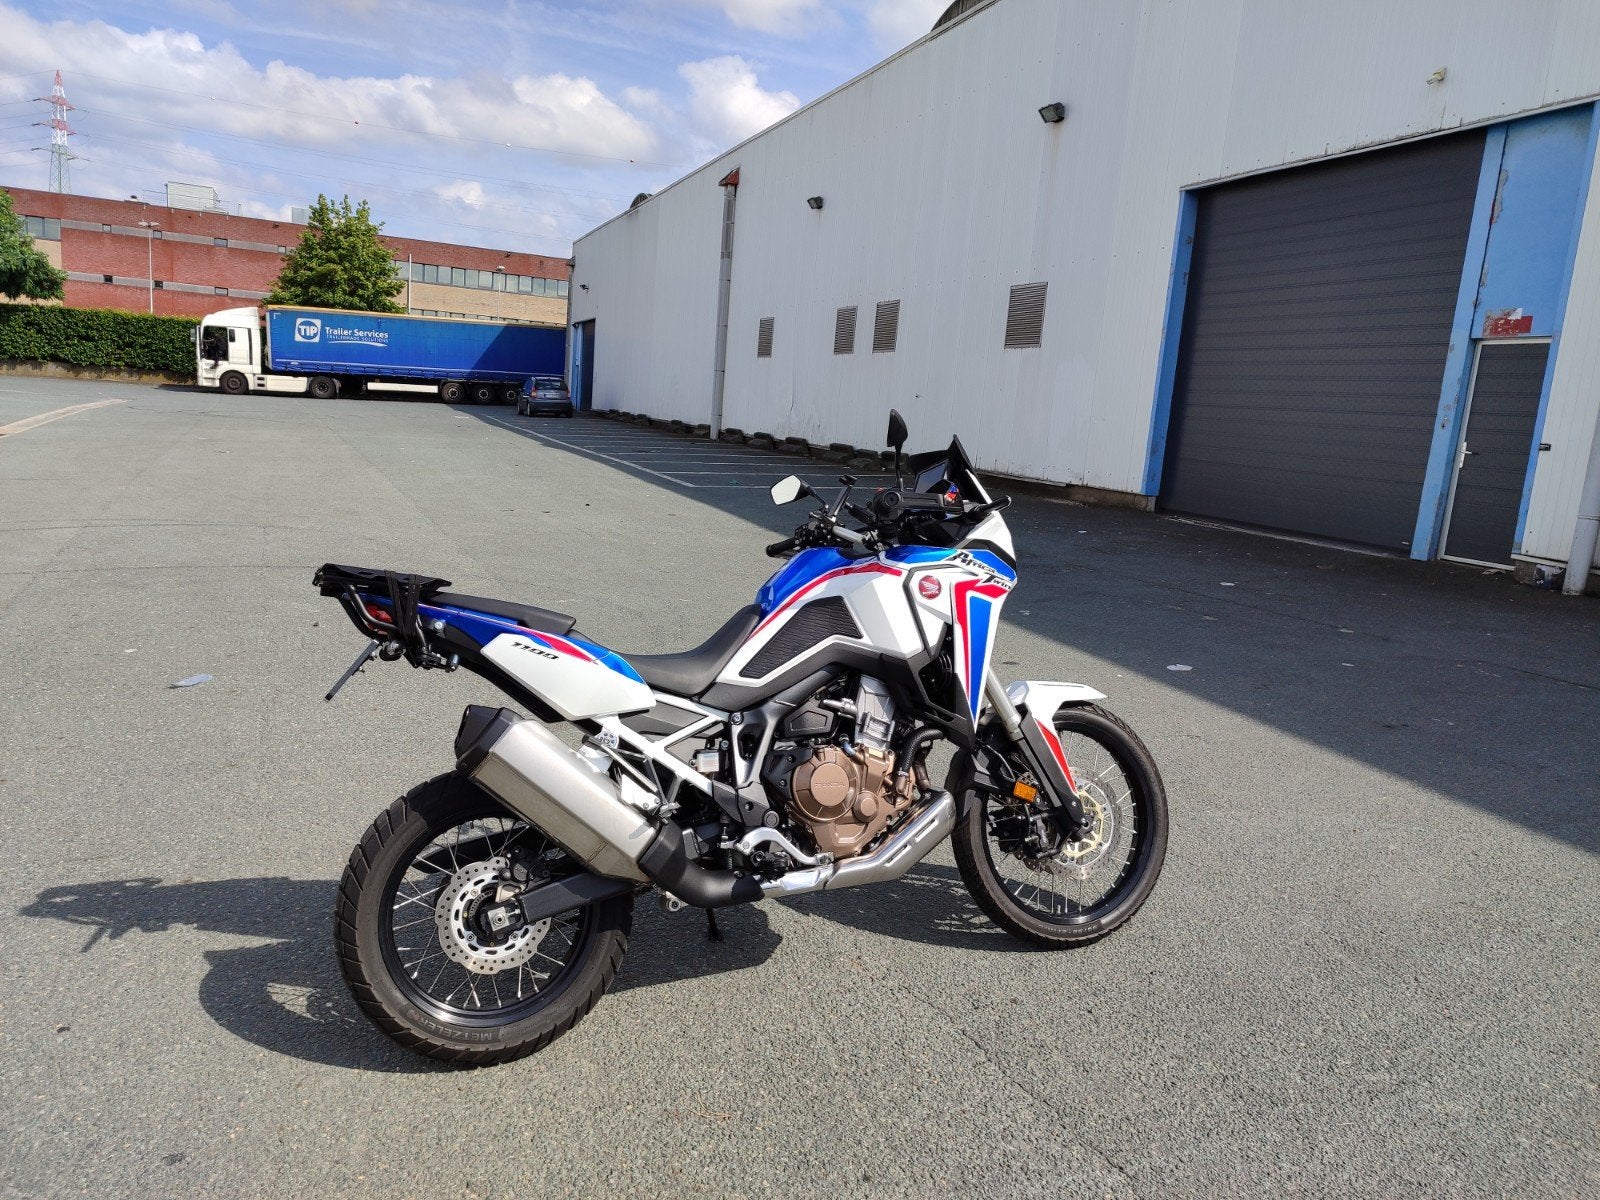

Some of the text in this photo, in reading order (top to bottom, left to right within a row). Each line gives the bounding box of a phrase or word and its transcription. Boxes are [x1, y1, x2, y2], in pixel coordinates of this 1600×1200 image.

[299, 325, 318, 337] TIP
[325, 326, 389, 339] Trailer Services
[944, 551, 1012, 590] Africa Twin
[511, 641, 560, 660] 1100
[418, 1016, 492, 1041] METZELER
